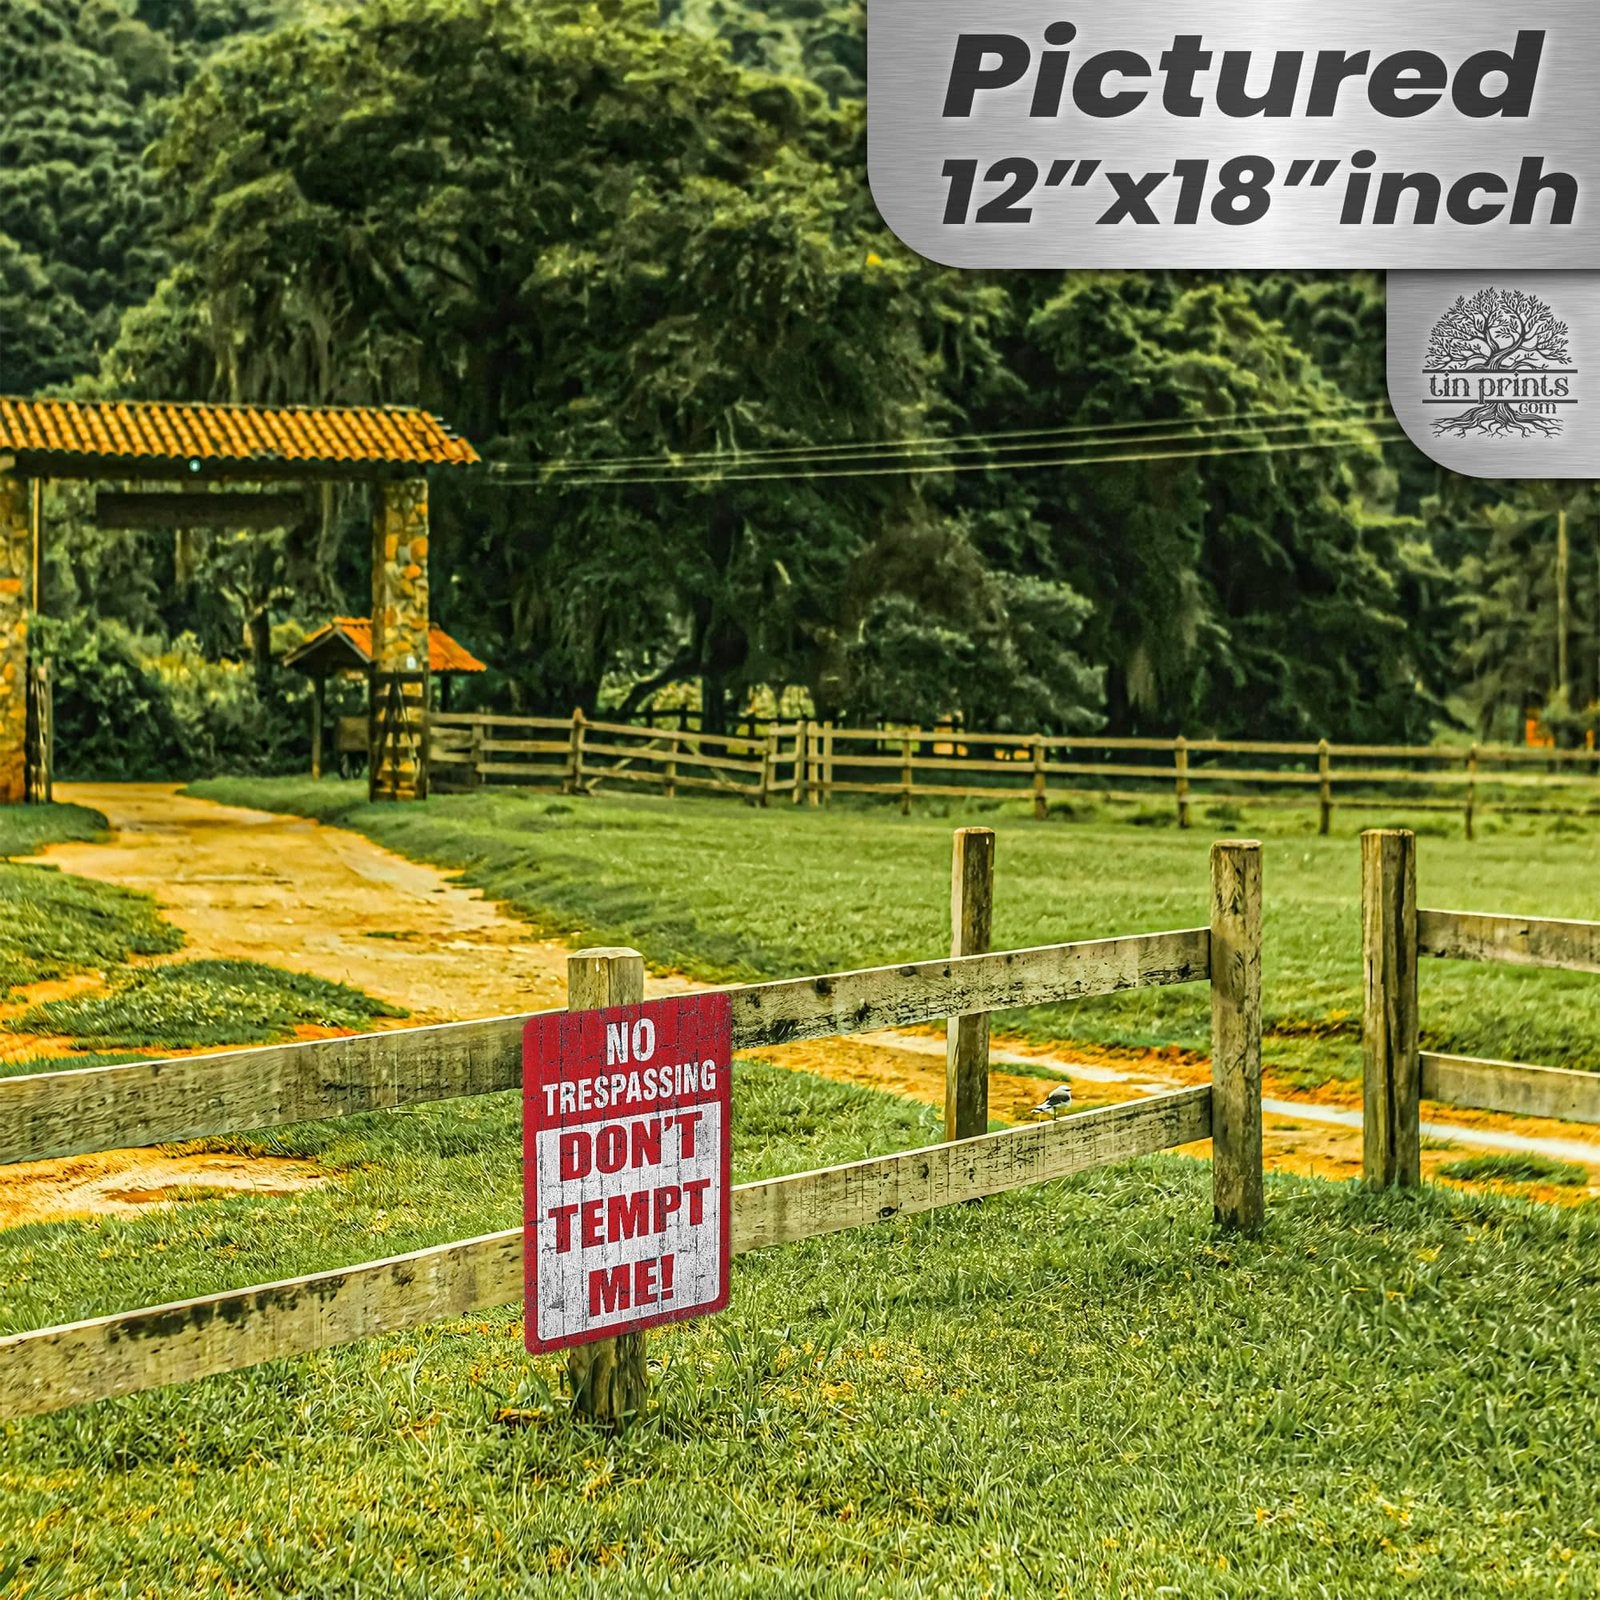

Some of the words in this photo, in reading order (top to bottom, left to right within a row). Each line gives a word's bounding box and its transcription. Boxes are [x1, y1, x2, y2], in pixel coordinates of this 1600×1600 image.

[606, 1018, 656, 1065] NO
[542, 1059, 716, 1116] TRESPASSING
[559, 1112, 703, 1182] DON'T
[547, 1178, 711, 1254] TEMPT
[588, 1253, 675, 1317] ME!
